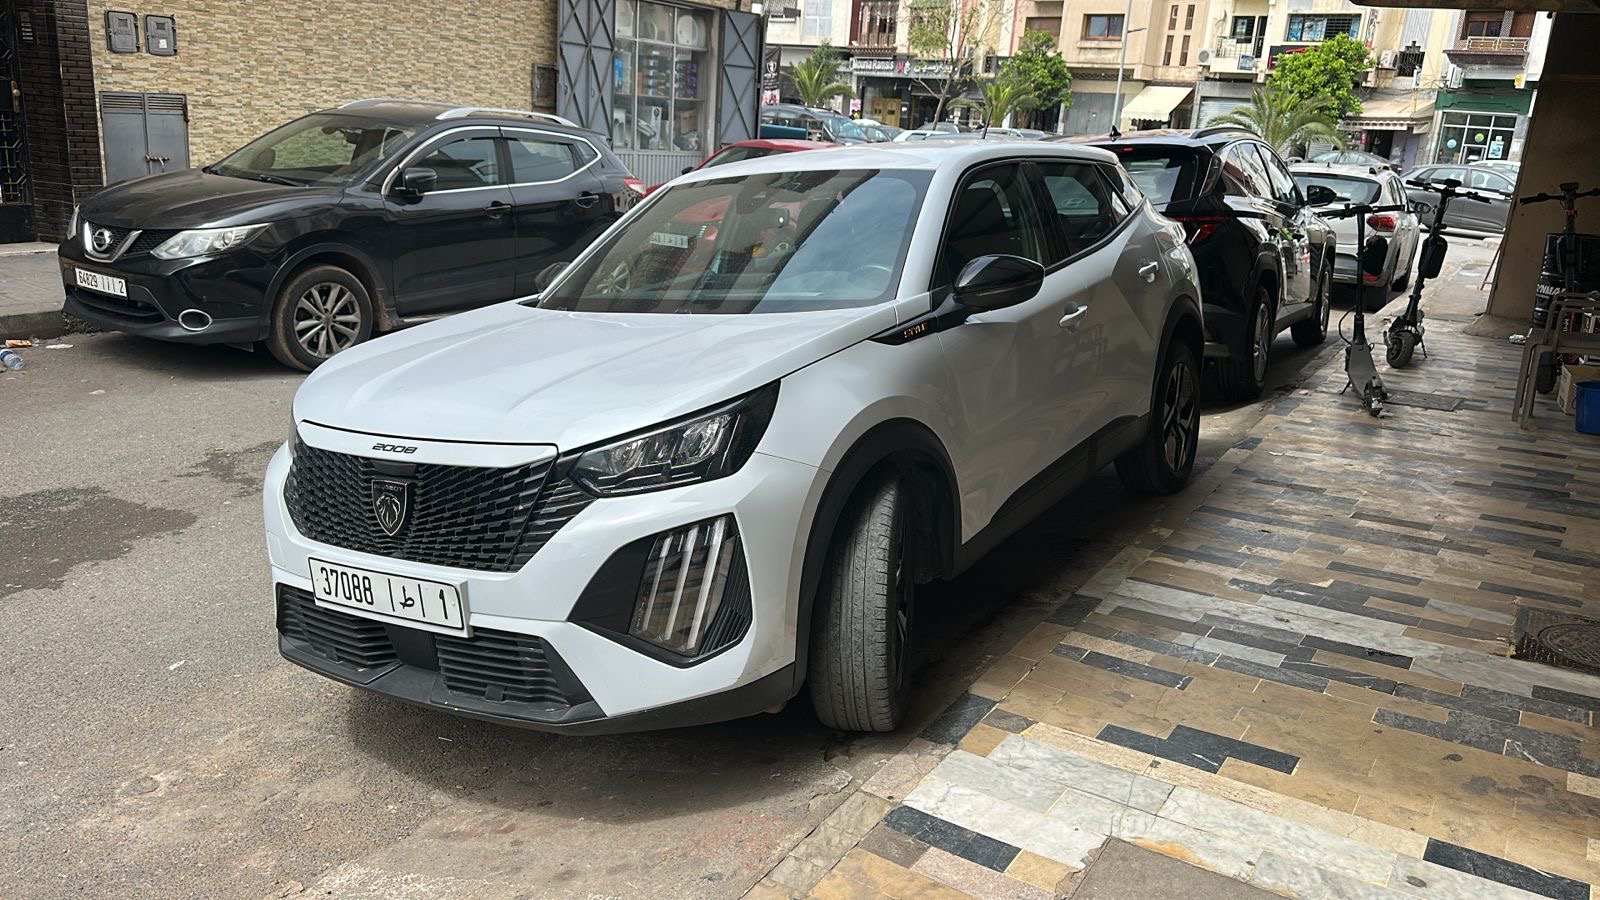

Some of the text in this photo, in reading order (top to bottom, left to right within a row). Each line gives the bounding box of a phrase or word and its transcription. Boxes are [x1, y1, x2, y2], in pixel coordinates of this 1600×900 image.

[118, 281, 124, 293] 2
[371, 443, 417, 454] 2008
[320, 566, 374, 606] 37088
[438, 589, 449, 620] 1
